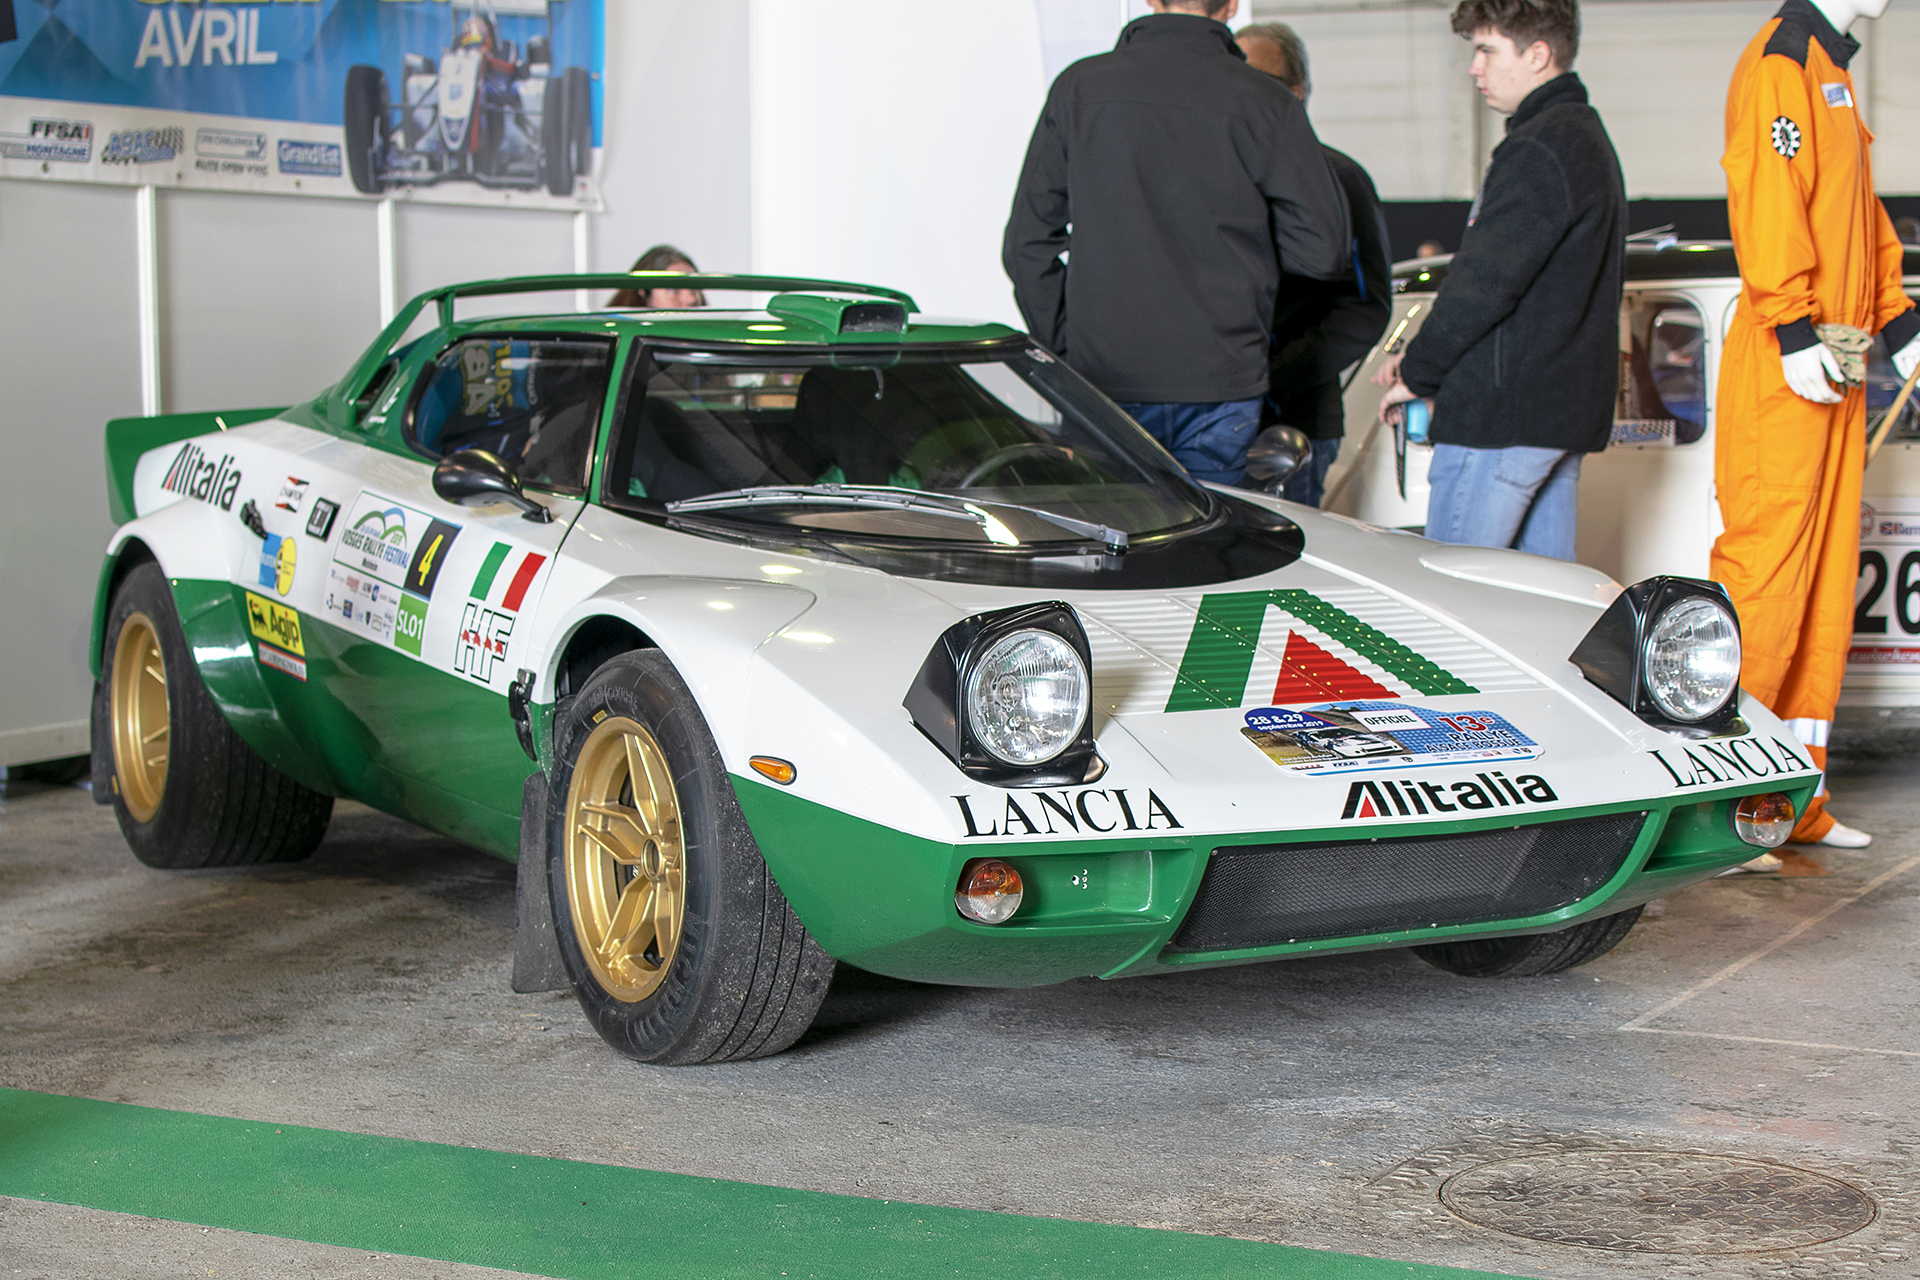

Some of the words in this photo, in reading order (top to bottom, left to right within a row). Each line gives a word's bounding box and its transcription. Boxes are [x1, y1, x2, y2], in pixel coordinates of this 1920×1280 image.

[133, 8, 278, 68] AVRIL
[31, 121, 83, 140] FFSA
[161, 442, 242, 512] Alitalia
[362, 537, 386, 559] RALLYE
[383, 545, 411, 569] FESTIVAL
[418, 534, 444, 587] 4
[270, 604, 300, 649] Agip
[1248, 715, 1268, 726] 28
[1286, 713, 1304, 723] 29
[1257, 722, 1304, 732] septembre
[1303, 720, 1324, 729] 2019
[1364, 714, 1417, 726] OFFICIEL
[1447, 729, 1513, 743] RALLYE
[1425, 741, 1473, 753] ALSACE
[1472, 739, 1523, 750] BOSSUE
[1647, 736, 1812, 789] LANCIA
[950, 787, 1185, 838] LANCIA
[1340, 771, 1560, 821] Alitalia
